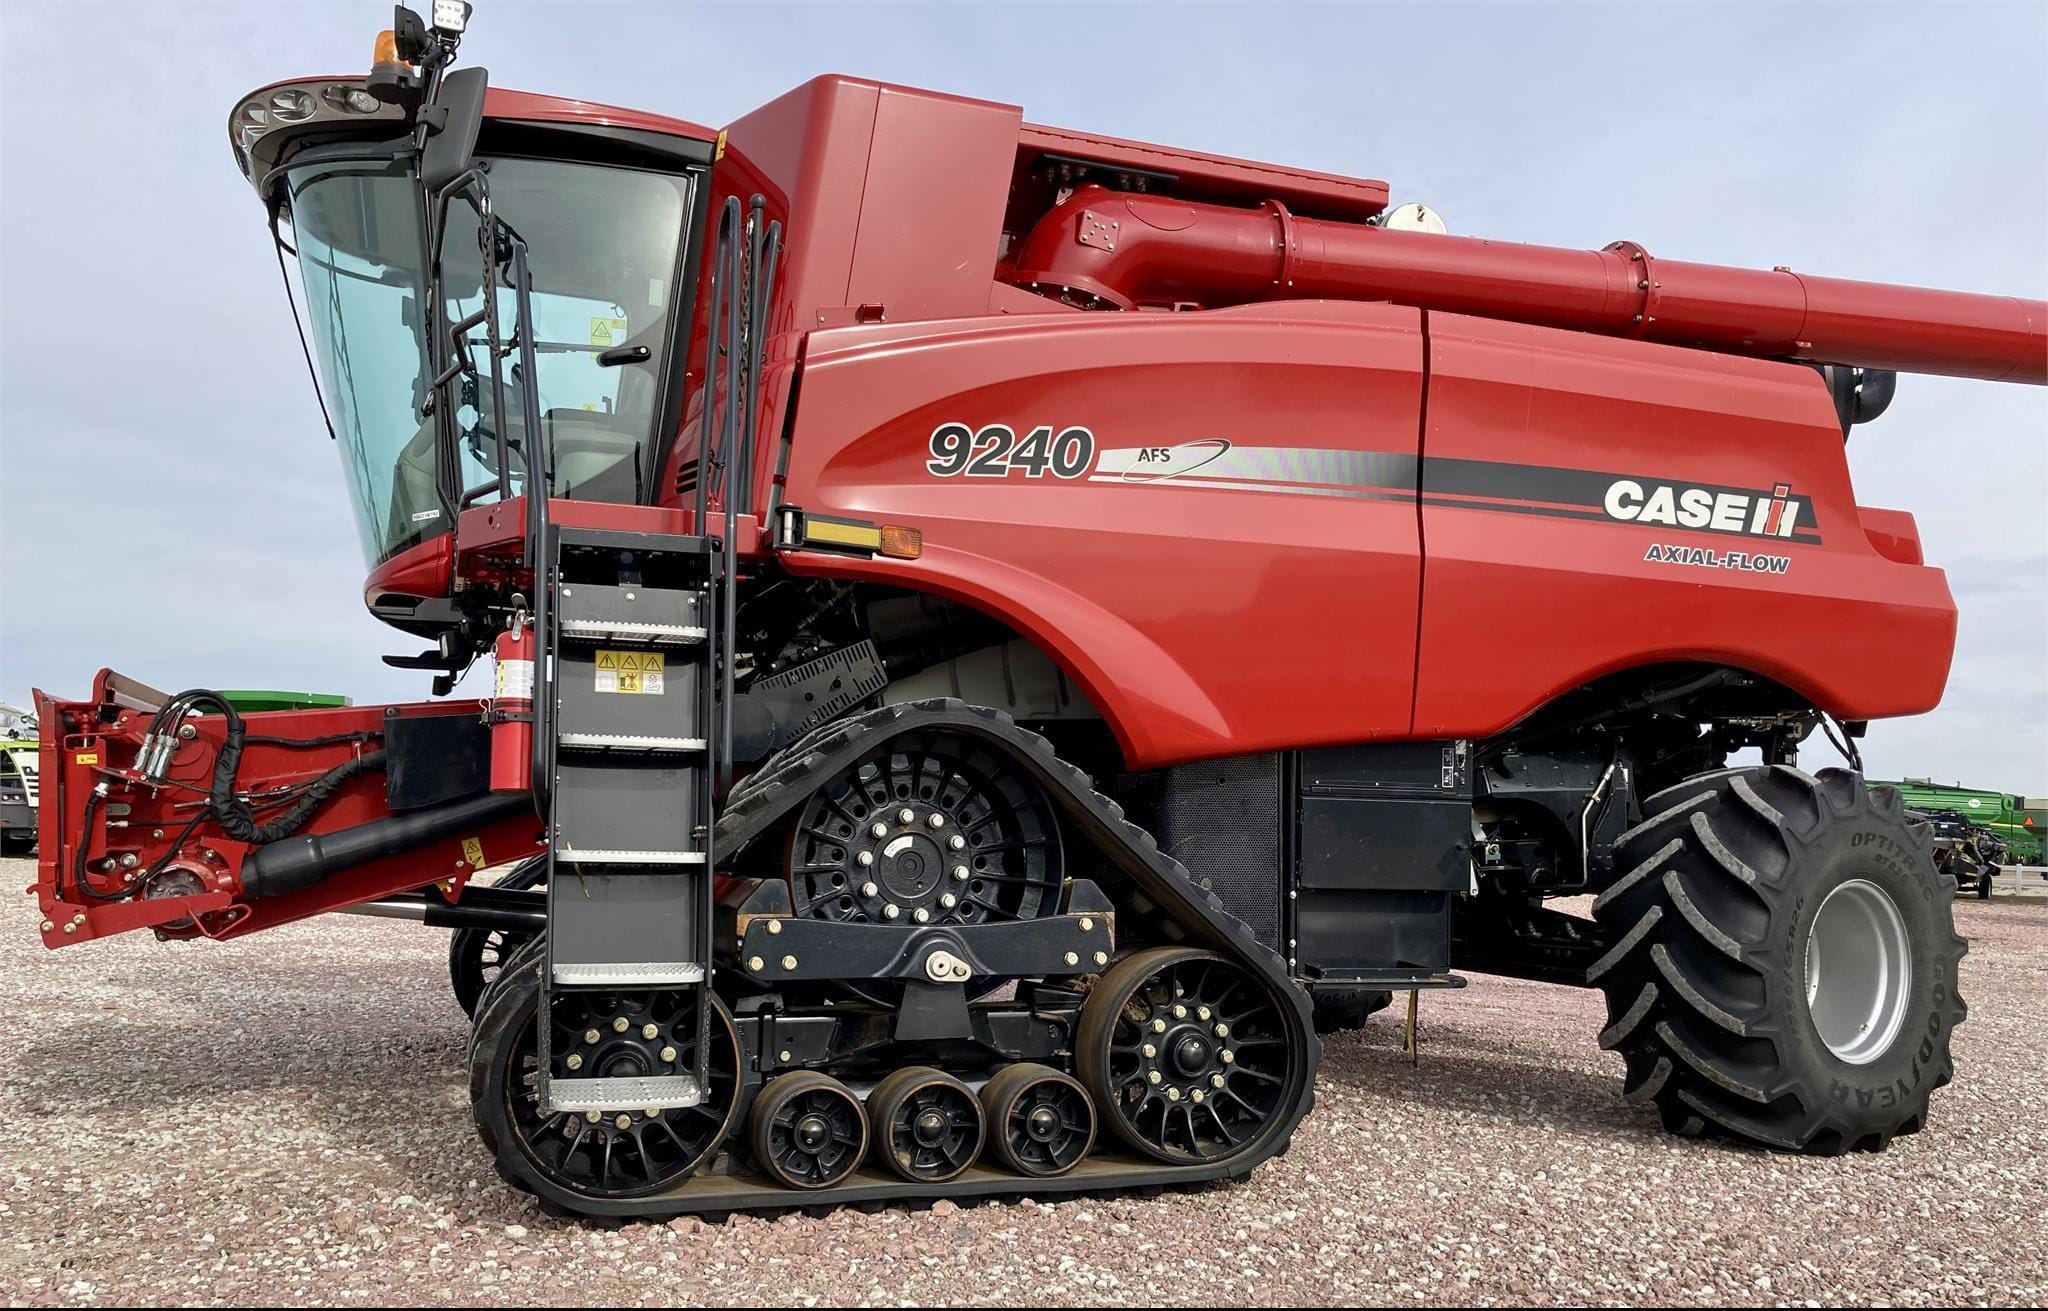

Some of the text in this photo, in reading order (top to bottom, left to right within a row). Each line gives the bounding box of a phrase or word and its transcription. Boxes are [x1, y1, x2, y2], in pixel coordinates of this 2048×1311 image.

[927, 422, 1171, 479] 9240 AFS
[1644, 544, 1791, 574] AXIAL-FLOW
[1851, 832, 1935, 902] OPTITRAC
[1828, 953, 1946, 1109] GOODYEAR
